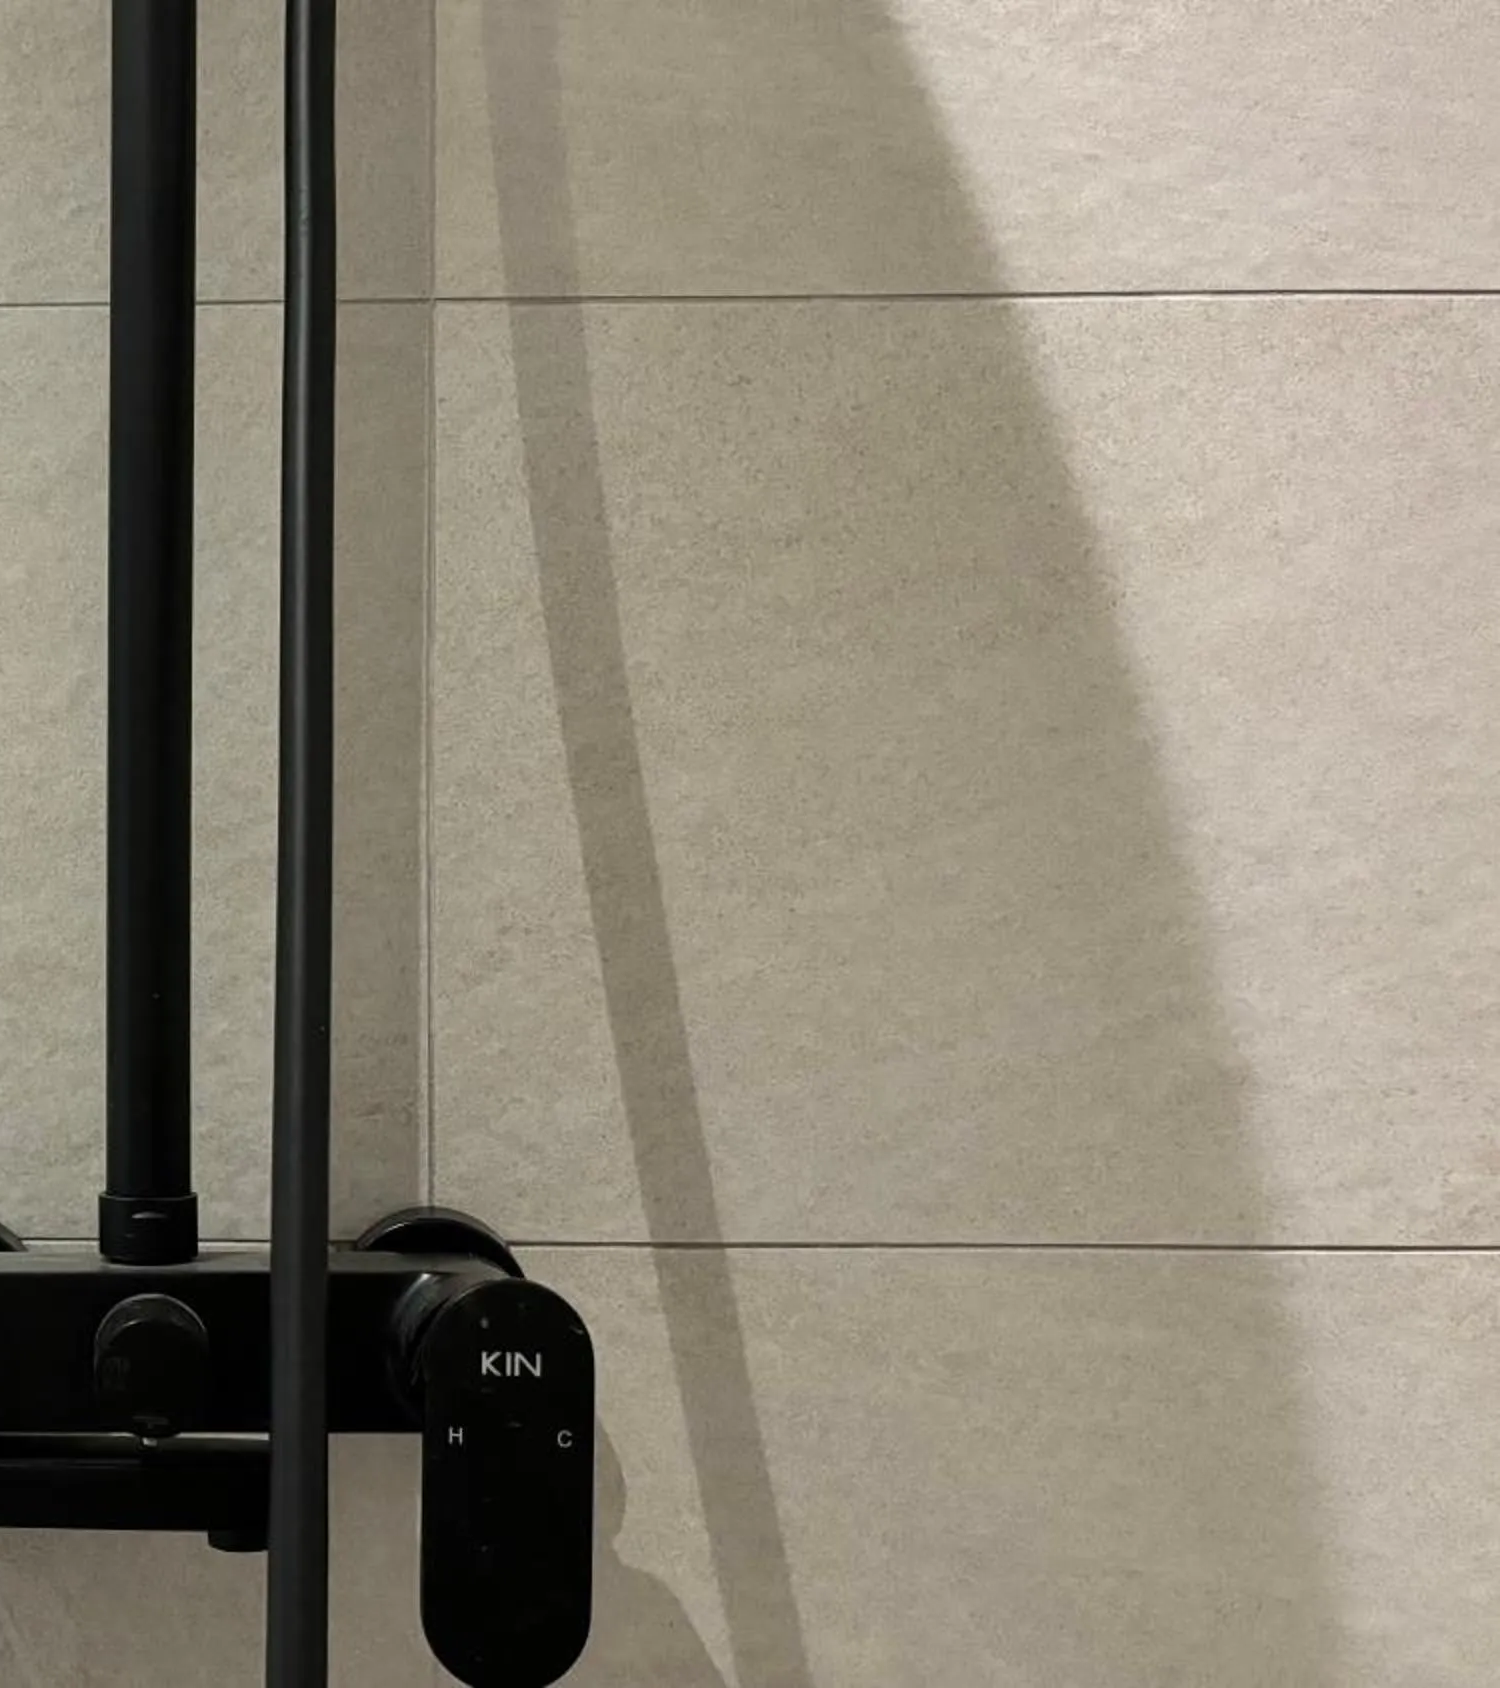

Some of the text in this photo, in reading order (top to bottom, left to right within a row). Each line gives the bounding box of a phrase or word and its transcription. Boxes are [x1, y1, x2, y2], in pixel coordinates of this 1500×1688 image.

[481, 1351, 542, 1377] KIN
[448, 1426, 463, 1445] H
[557, 1429, 573, 1448] C
